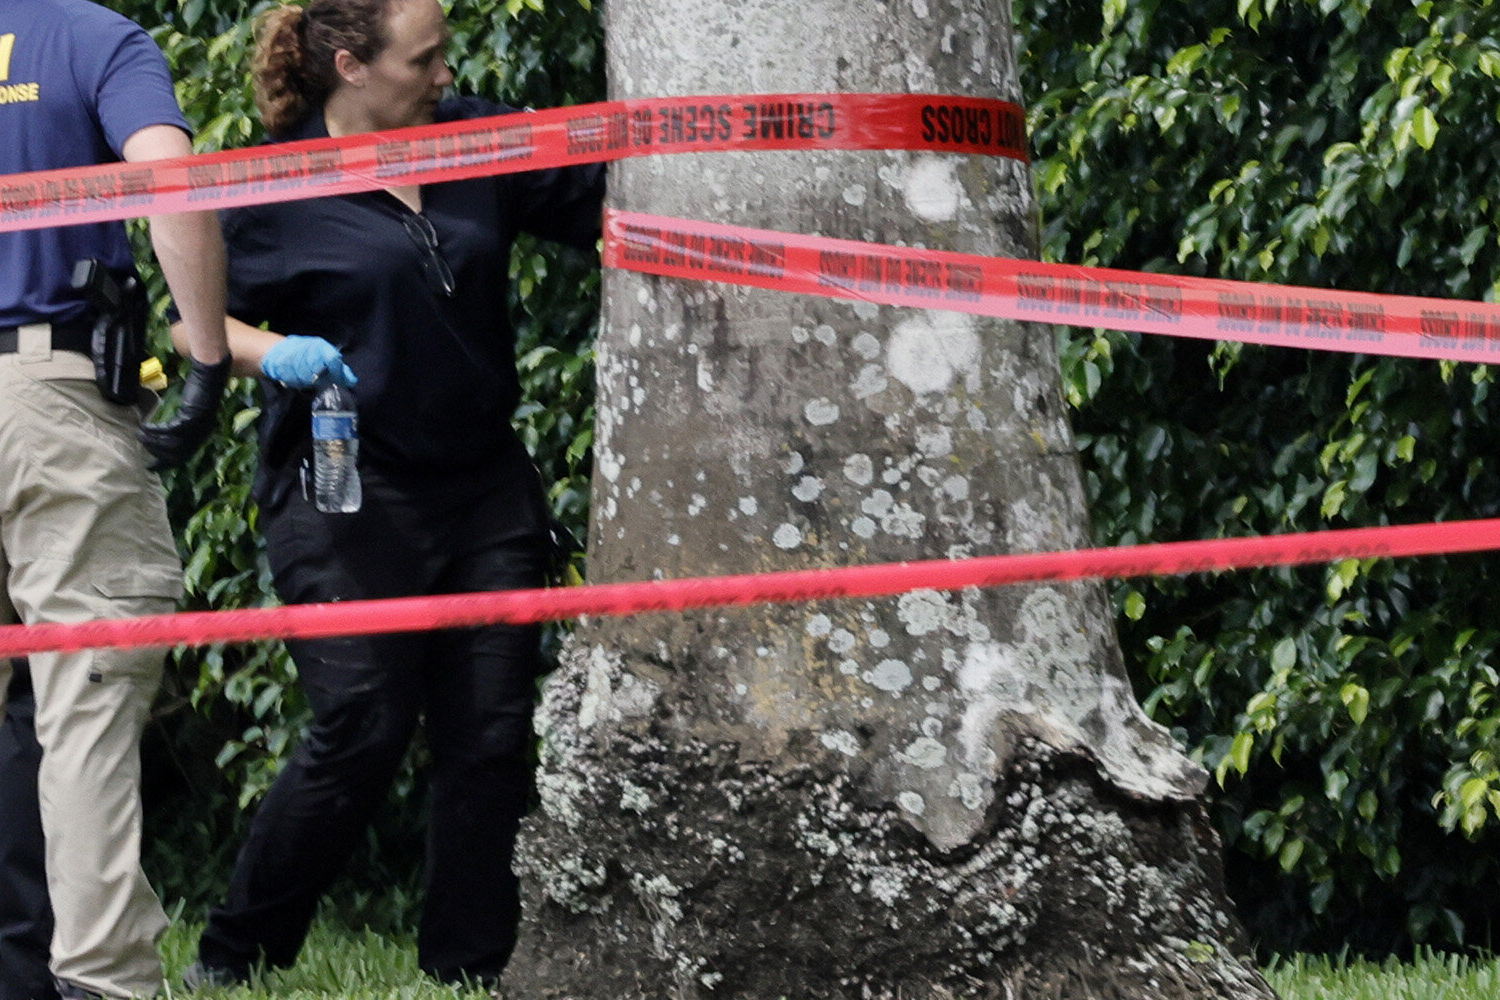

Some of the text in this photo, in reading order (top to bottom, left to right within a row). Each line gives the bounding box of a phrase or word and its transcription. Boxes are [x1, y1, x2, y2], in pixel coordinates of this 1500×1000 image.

[658, 103, 732, 144] SCENE
[743, 101, 836, 140] CRIME
[921, 104, 991, 145] CROSS
